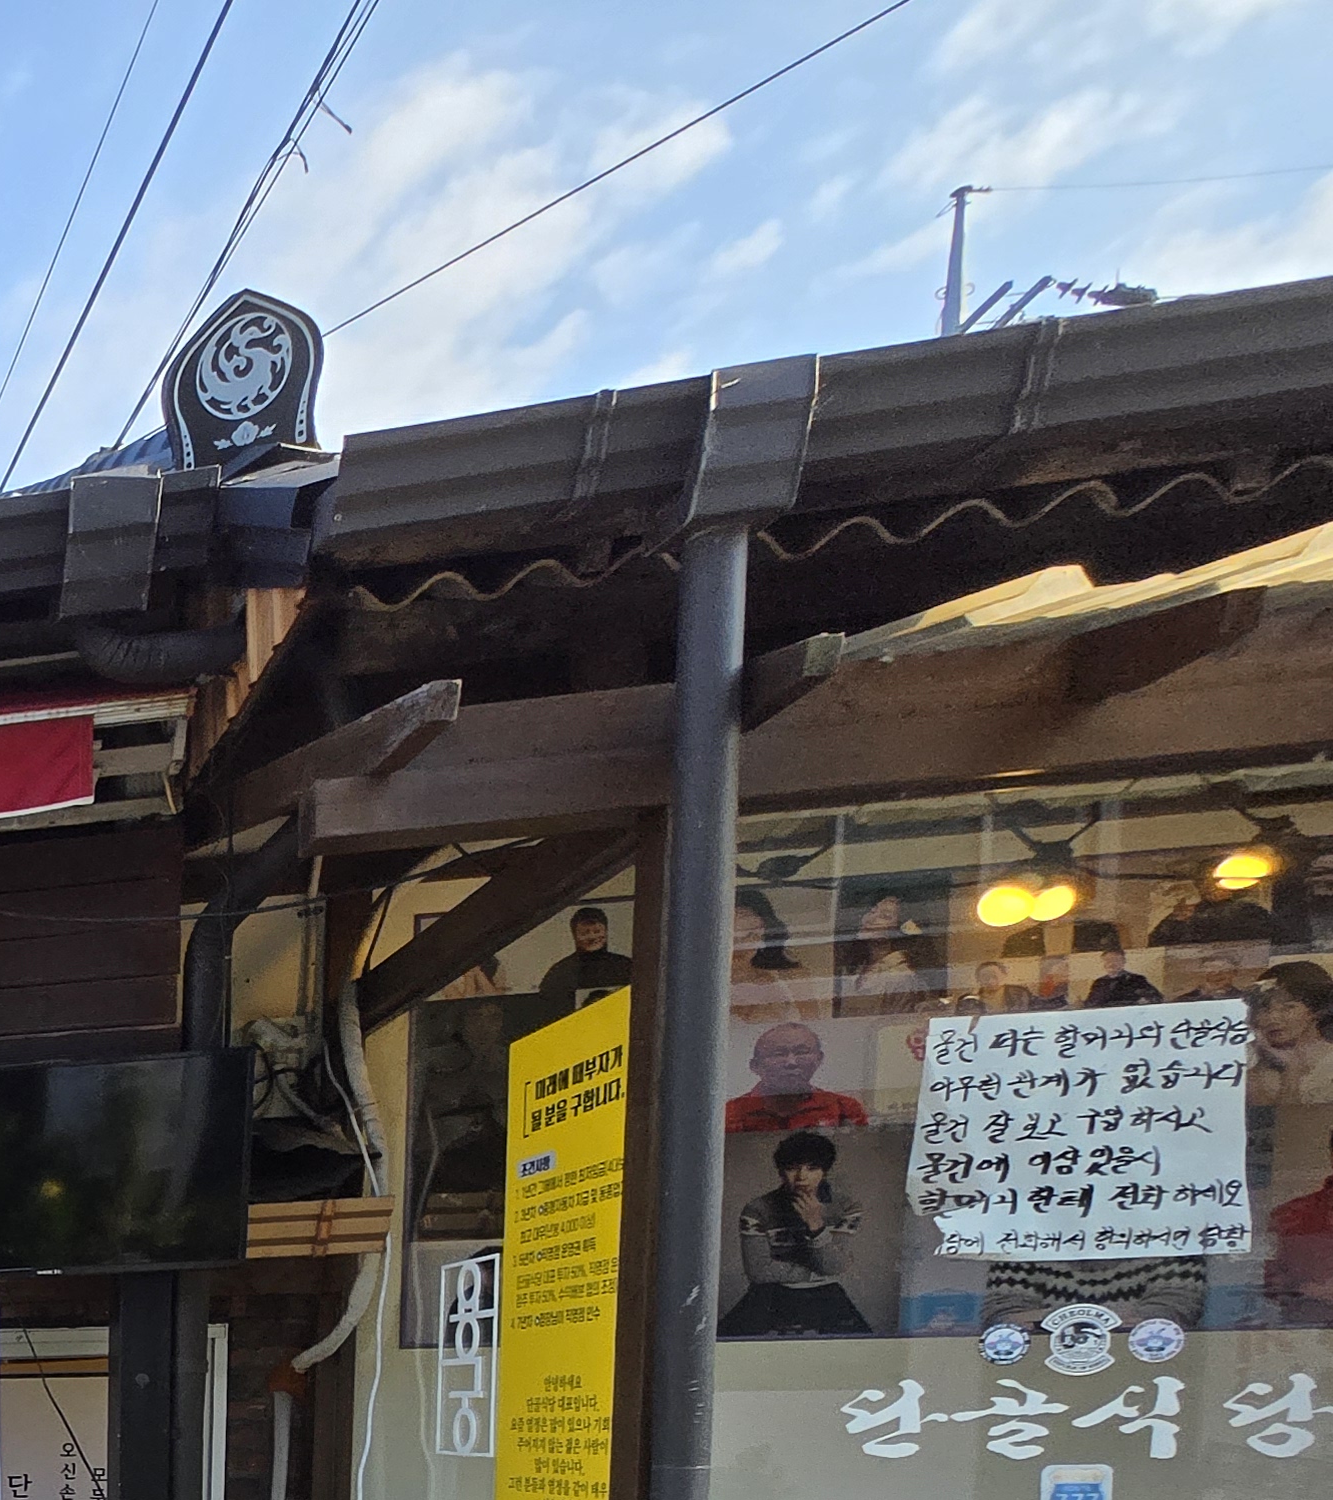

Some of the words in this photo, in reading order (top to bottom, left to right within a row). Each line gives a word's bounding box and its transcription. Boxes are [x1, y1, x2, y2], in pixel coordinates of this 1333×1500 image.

[933, 1029, 978, 1066] 물건
[1054, 1021, 1163, 1058] 할머니와
[930, 1072, 1002, 1102] 아무런
[1120, 1058, 1246, 1092] 없습니다
[545, 1099, 567, 1127] 분을
[571, 1077, 625, 1116] 구합니다.
[920, 1111, 969, 1144] 물건
[983, 1111, 1014, 1143] 잘
[916, 1152, 1010, 1183] 물건에
[1052, 1308, 1112, 1328] CHEOLMA
[544, 1374, 582, 1392] 안녕하세요
[527, 1396, 555, 1412] 단골식당
[841, 1372, 1333, 1460] 단골식당
